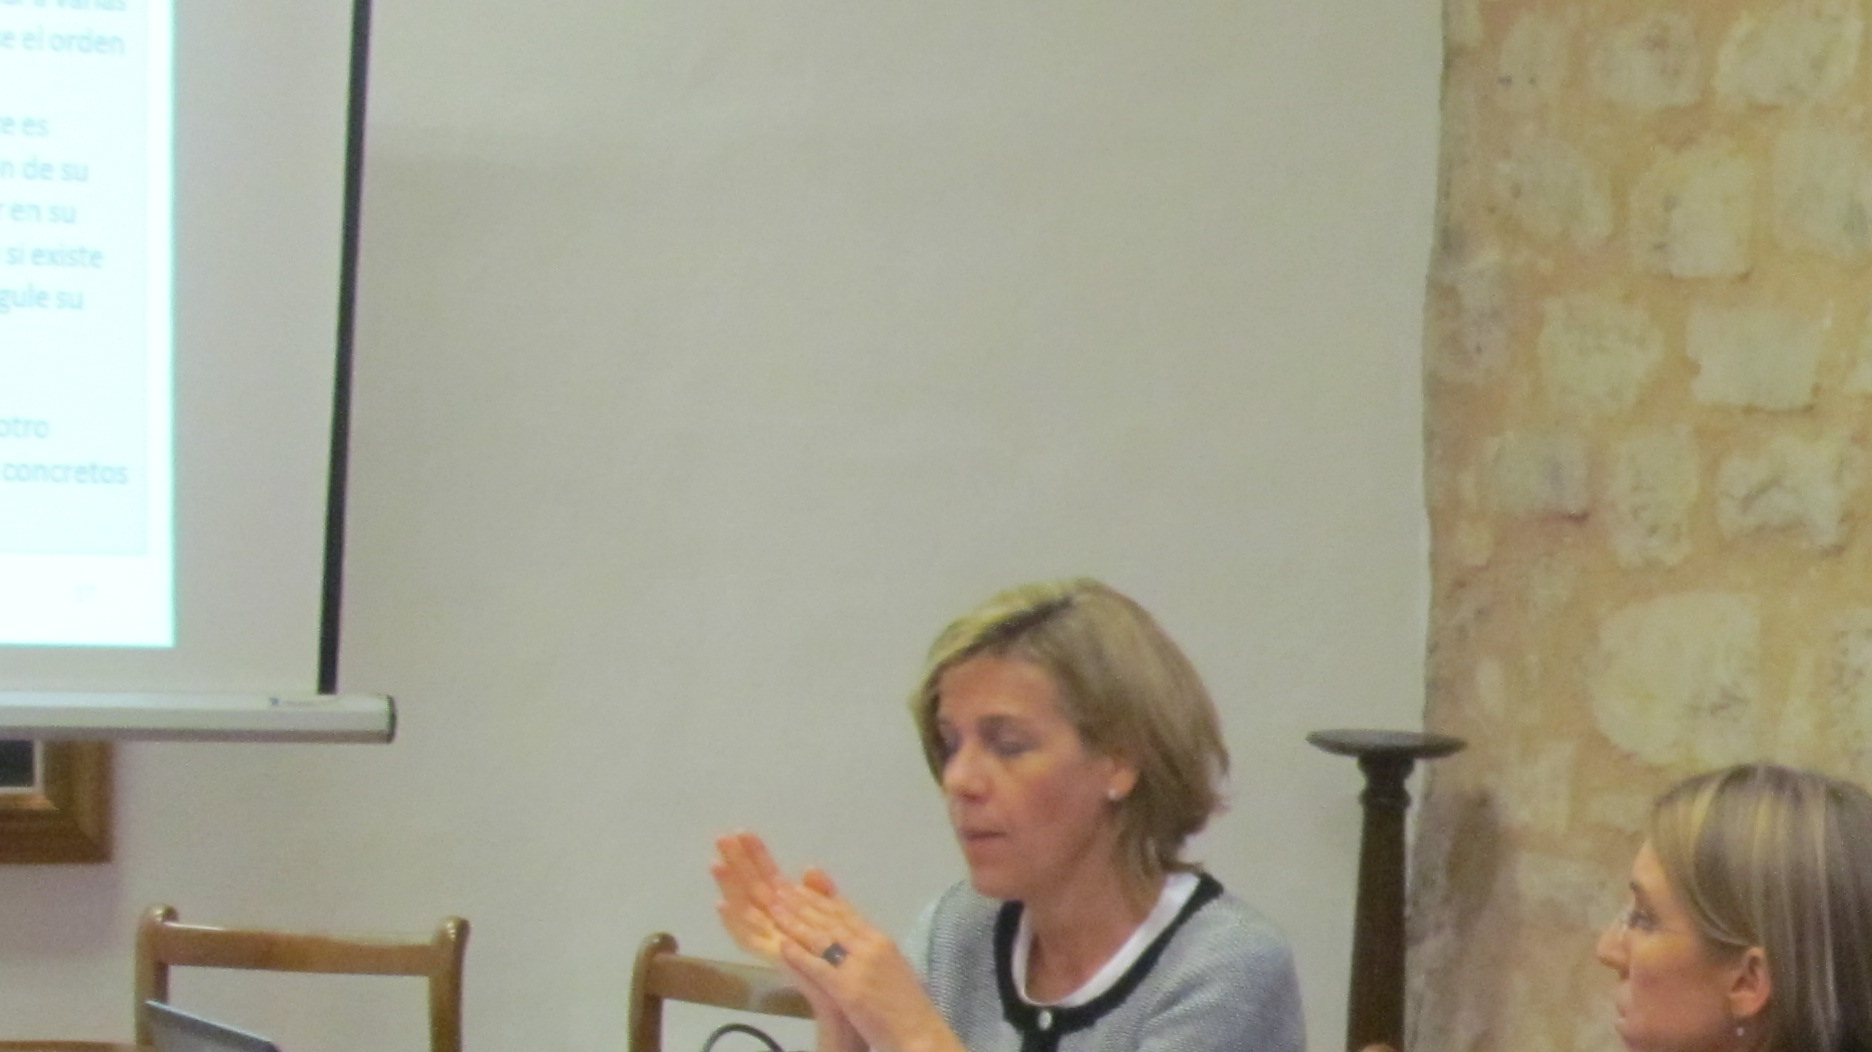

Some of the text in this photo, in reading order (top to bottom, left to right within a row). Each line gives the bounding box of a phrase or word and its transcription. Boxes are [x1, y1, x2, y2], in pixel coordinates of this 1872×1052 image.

[48, 27, 126, 55] orden
[21, 117, 49, 138] es
[22, 155, 54, 182] de
[61, 161, 89, 184] su
[9, 202, 42, 223] en
[47, 205, 76, 225] su
[30, 242, 104, 269] existe
[56, 290, 84, 311] su
[2, 462, 129, 485] concretos
